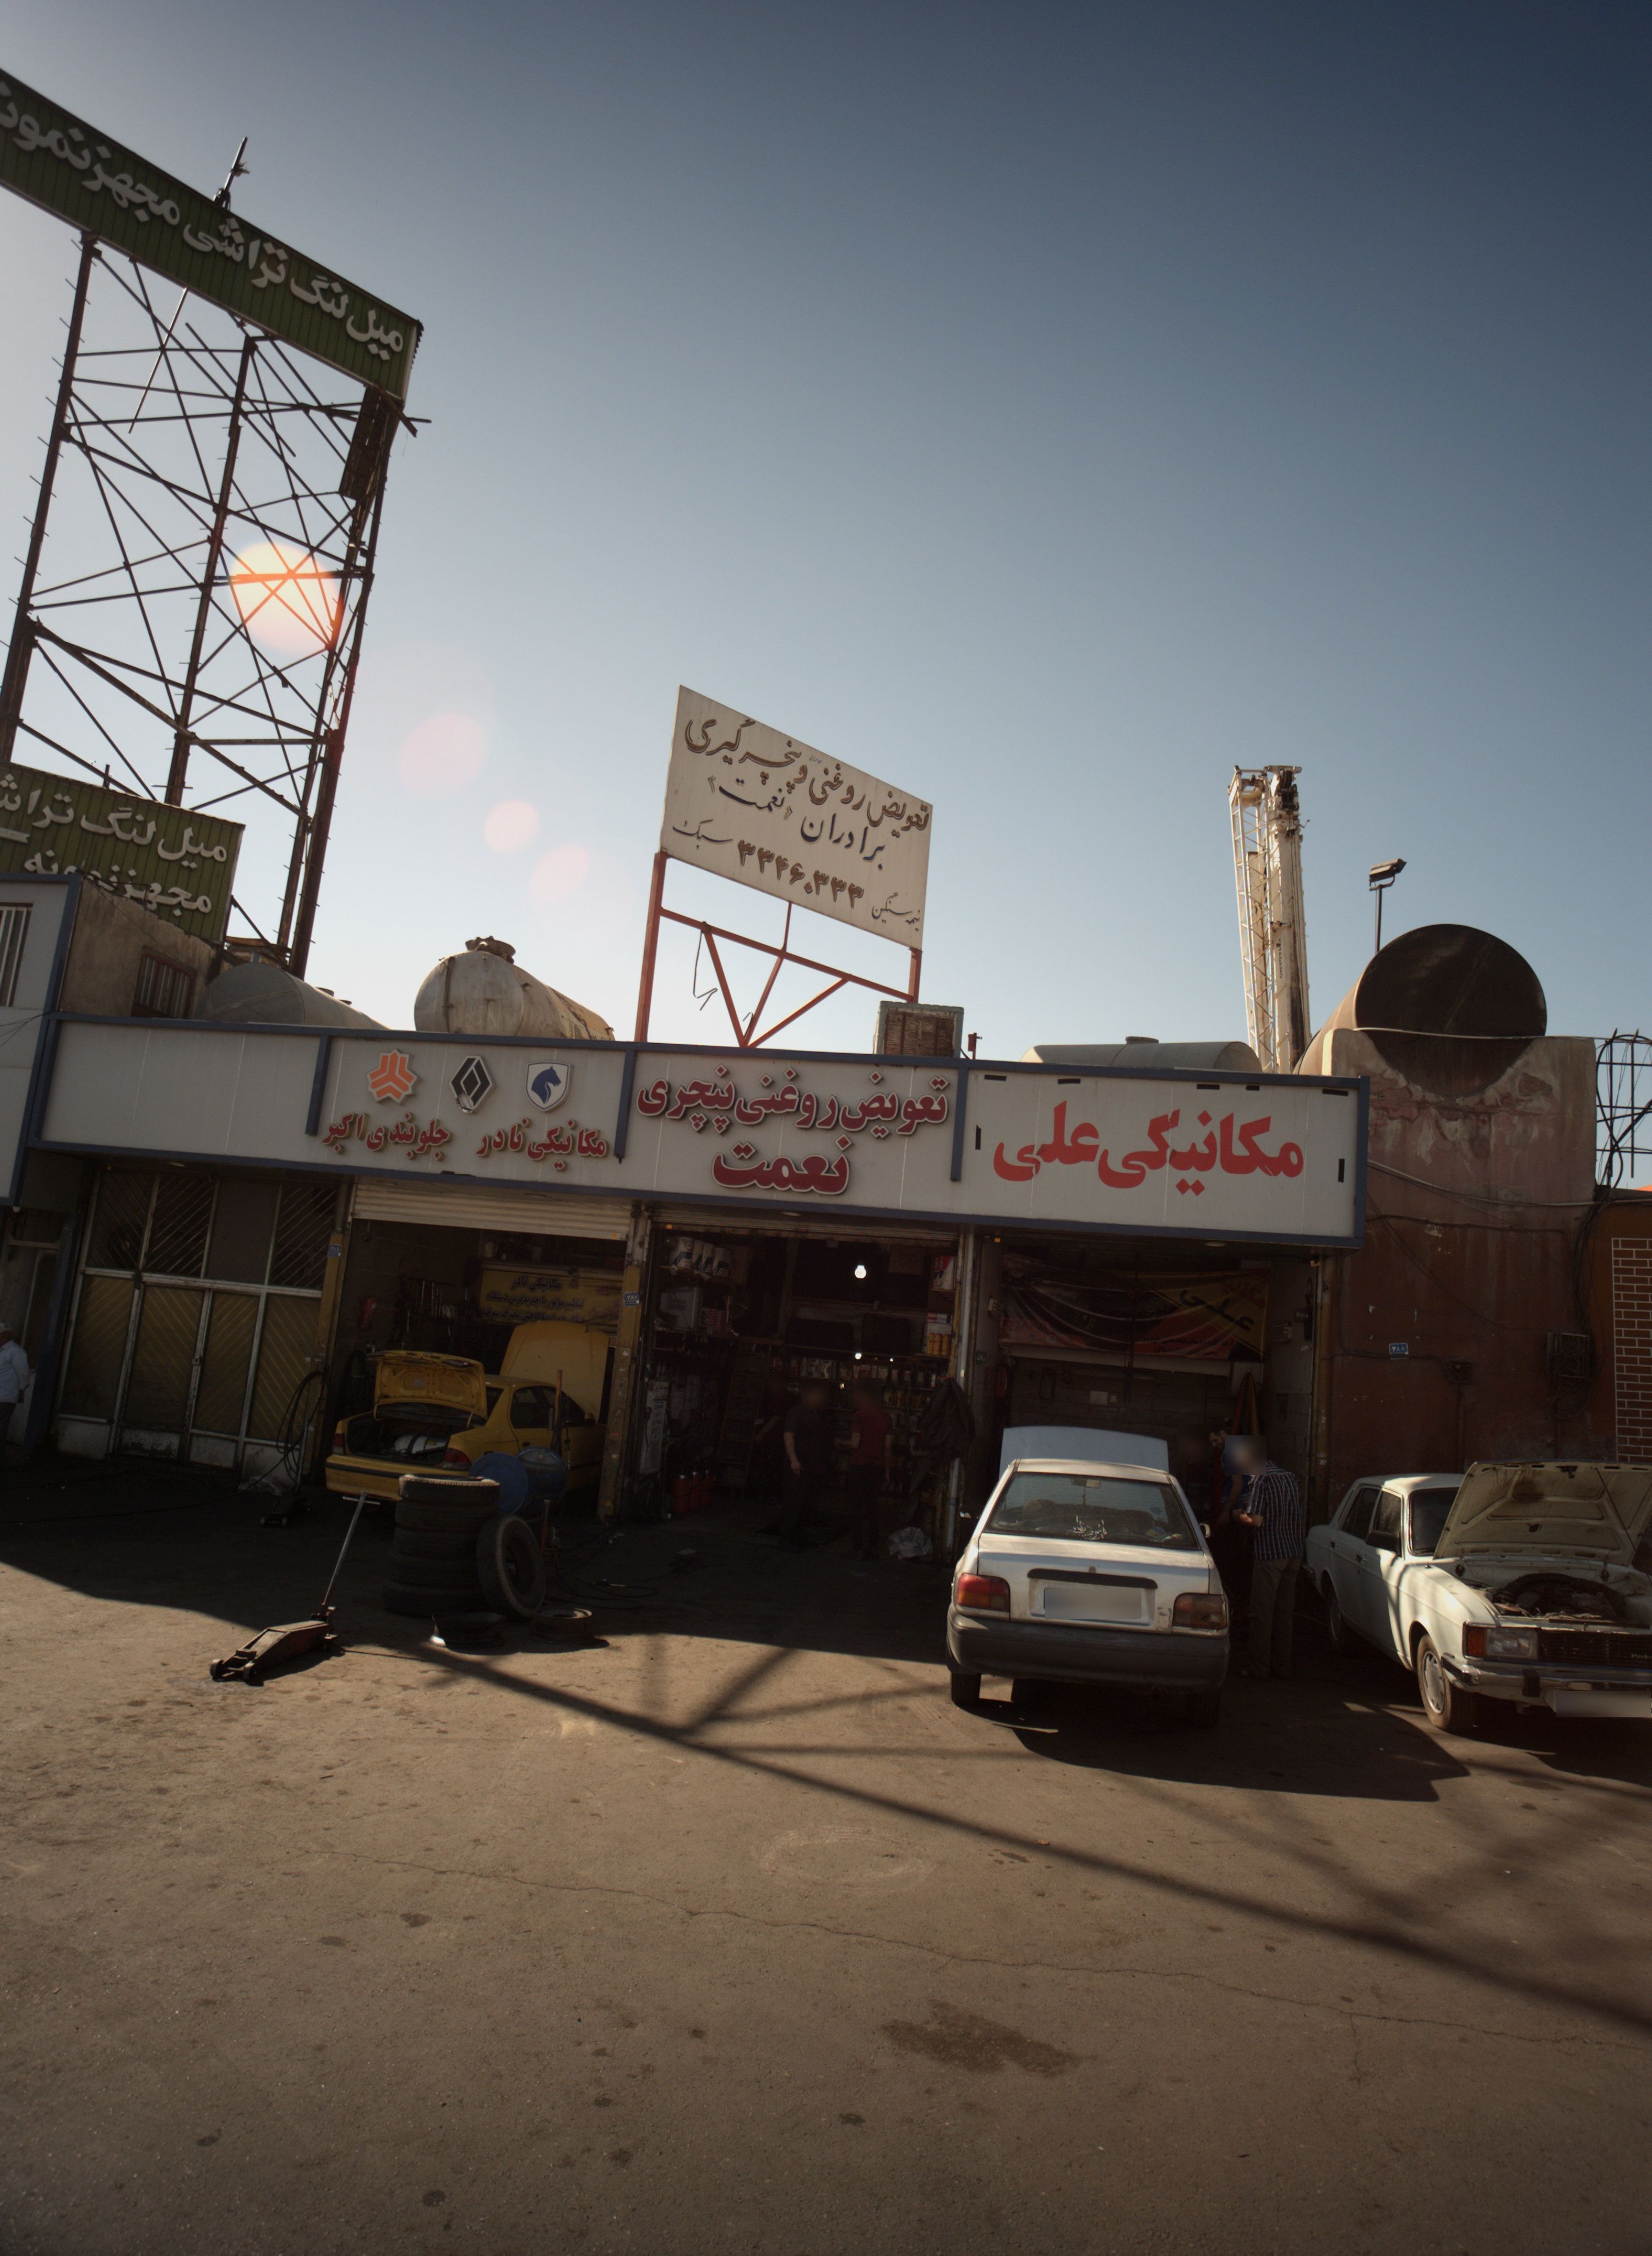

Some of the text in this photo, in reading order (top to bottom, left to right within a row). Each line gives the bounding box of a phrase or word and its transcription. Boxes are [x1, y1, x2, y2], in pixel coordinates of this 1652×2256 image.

[0, 83, 404, 361] میل لنگ تراشی مجهز نمون
[80, 807, 156, 846] لنگ
[672, 818, 733, 850] سبک
[866, 790, 929, 838] تعویض
[157, 827, 227, 870] میل
[800, 813, 885, 871] برادران
[123, 868, 212, 917] مجهز
[871, 891, 913, 924] سنگین
[635, 1063, 950, 1140] تعویض روغنی پنچری
[322, 1111, 367, 1154] اکبر
[476, 1116, 608, 1172] مکانیکی نادر
[992, 1099, 1304, 1197] مکانیکی علی
[711, 1133, 854, 1195] نعمت
[529, 1276, 563, 1292] مکانیکی
